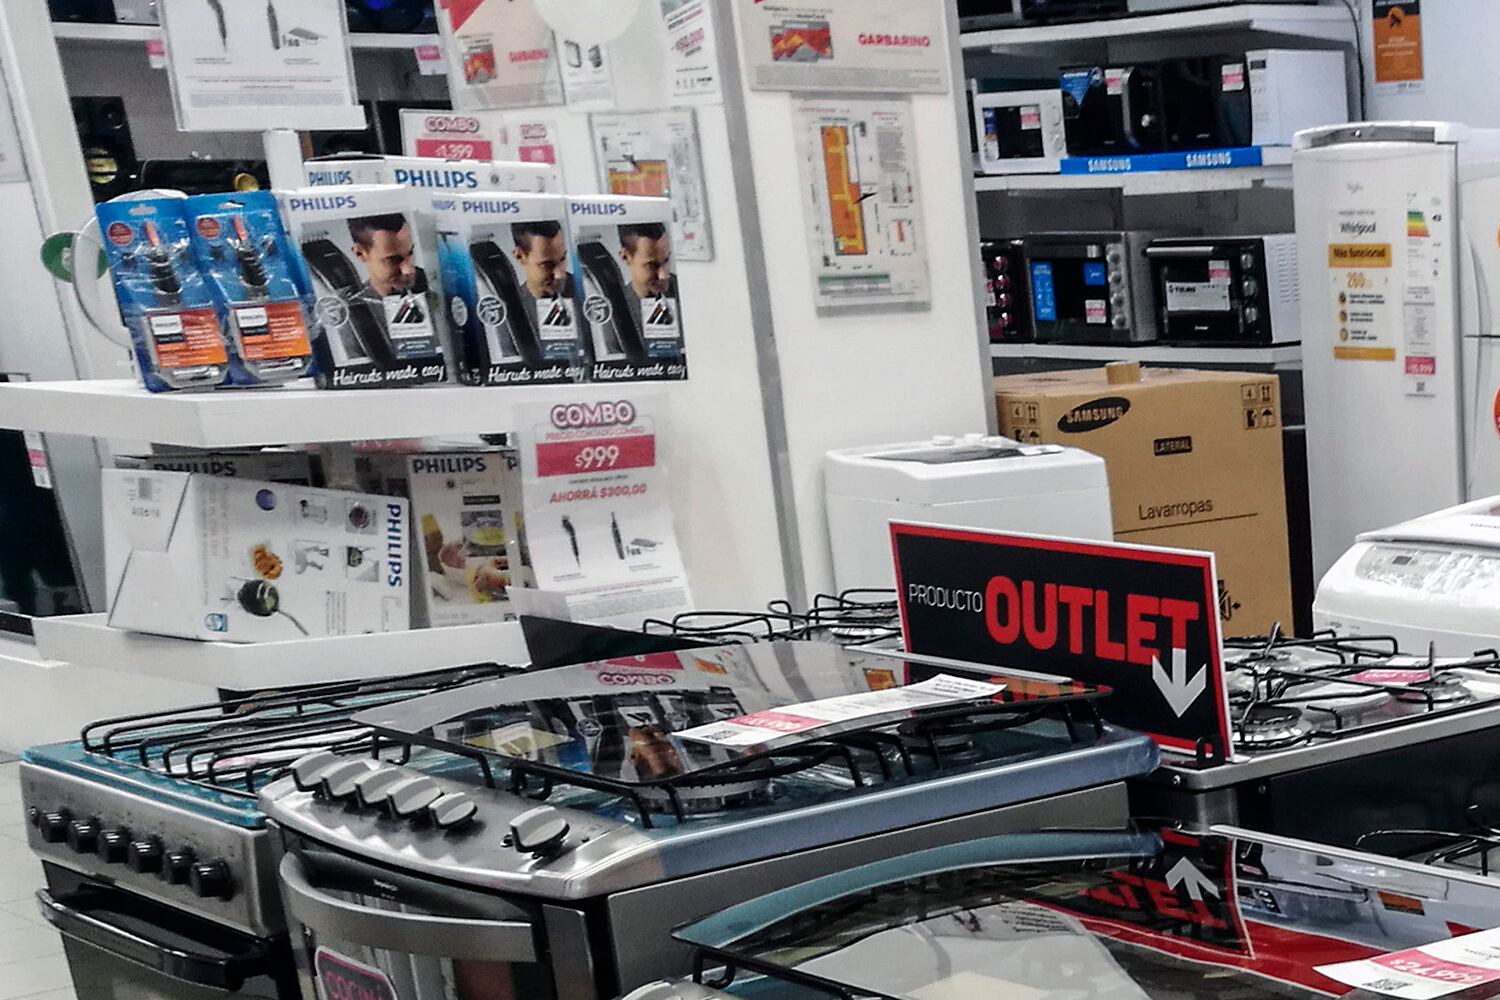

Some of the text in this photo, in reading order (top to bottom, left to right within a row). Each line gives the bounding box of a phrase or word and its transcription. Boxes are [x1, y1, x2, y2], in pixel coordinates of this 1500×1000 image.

[858, 33, 931, 47] GARBARINO
[425, 116, 479, 133] COMBO
[1088, 151, 1232, 173] SAMSUNG SAMSUNG
[309, 170, 352, 186] PHILIPS
[395, 169, 478, 190] PHILIPS
[290, 195, 356, 211] PHILIPS
[462, 200, 520, 214] PHILIPS
[571, 202, 626, 216] PHILIPS
[333, 364, 444, 385] Haircuts made easy
[489, 366, 533, 383] Haircuts
[535, 366, 563, 380] made
[593, 364, 638, 381] Haircuts
[638, 363, 666, 378] made
[552, 401, 635, 428] COMBO
[1066, 404, 1124, 423] SAMSUNG
[1155, 437, 1192, 453] LATERAL
[412, 456, 486, 474] PHILIPS
[575, 445, 620, 467] $999
[550, 487, 598, 504] AHORRÁ
[1138, 499, 1214, 521] Lavarropas
[386, 503, 403, 588] PHILIPS
[908, 576, 1199, 666] PRODUCTO OUTLET
